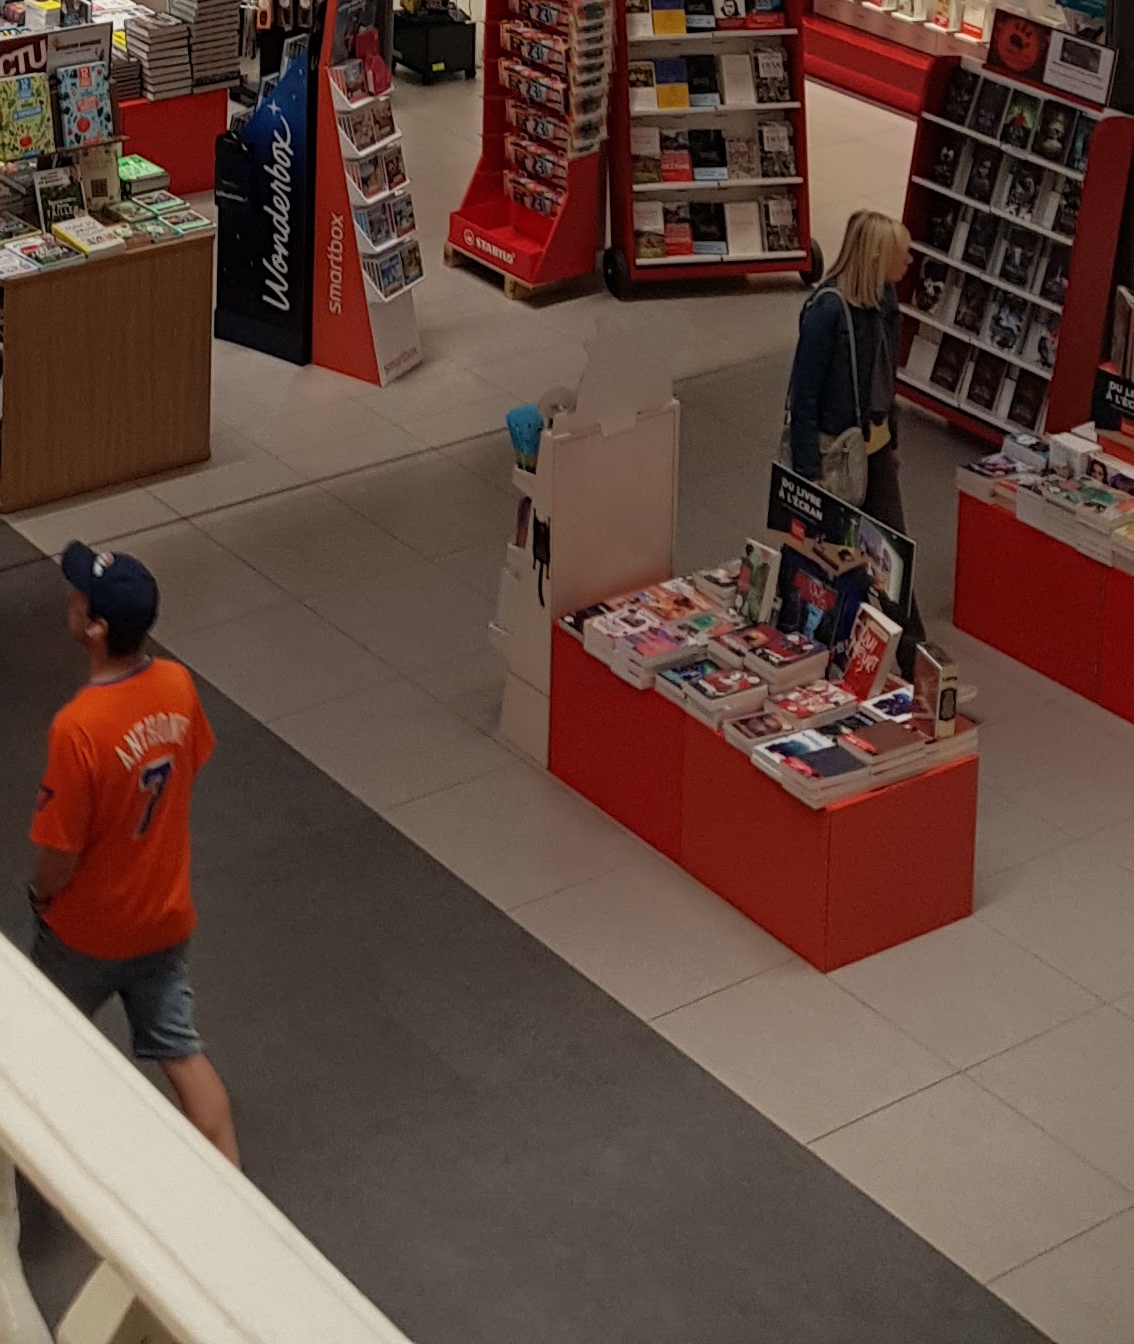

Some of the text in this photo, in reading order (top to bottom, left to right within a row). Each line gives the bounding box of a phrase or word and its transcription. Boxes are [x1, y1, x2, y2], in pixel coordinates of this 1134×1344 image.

[262, 115, 295, 311] Wonderbox
[476, 236, 514, 265] STABILO
[328, 211, 345, 314] smartbox
[781, 476, 823, 509] DU LIVRE
[137, 755, 174, 839] 7
